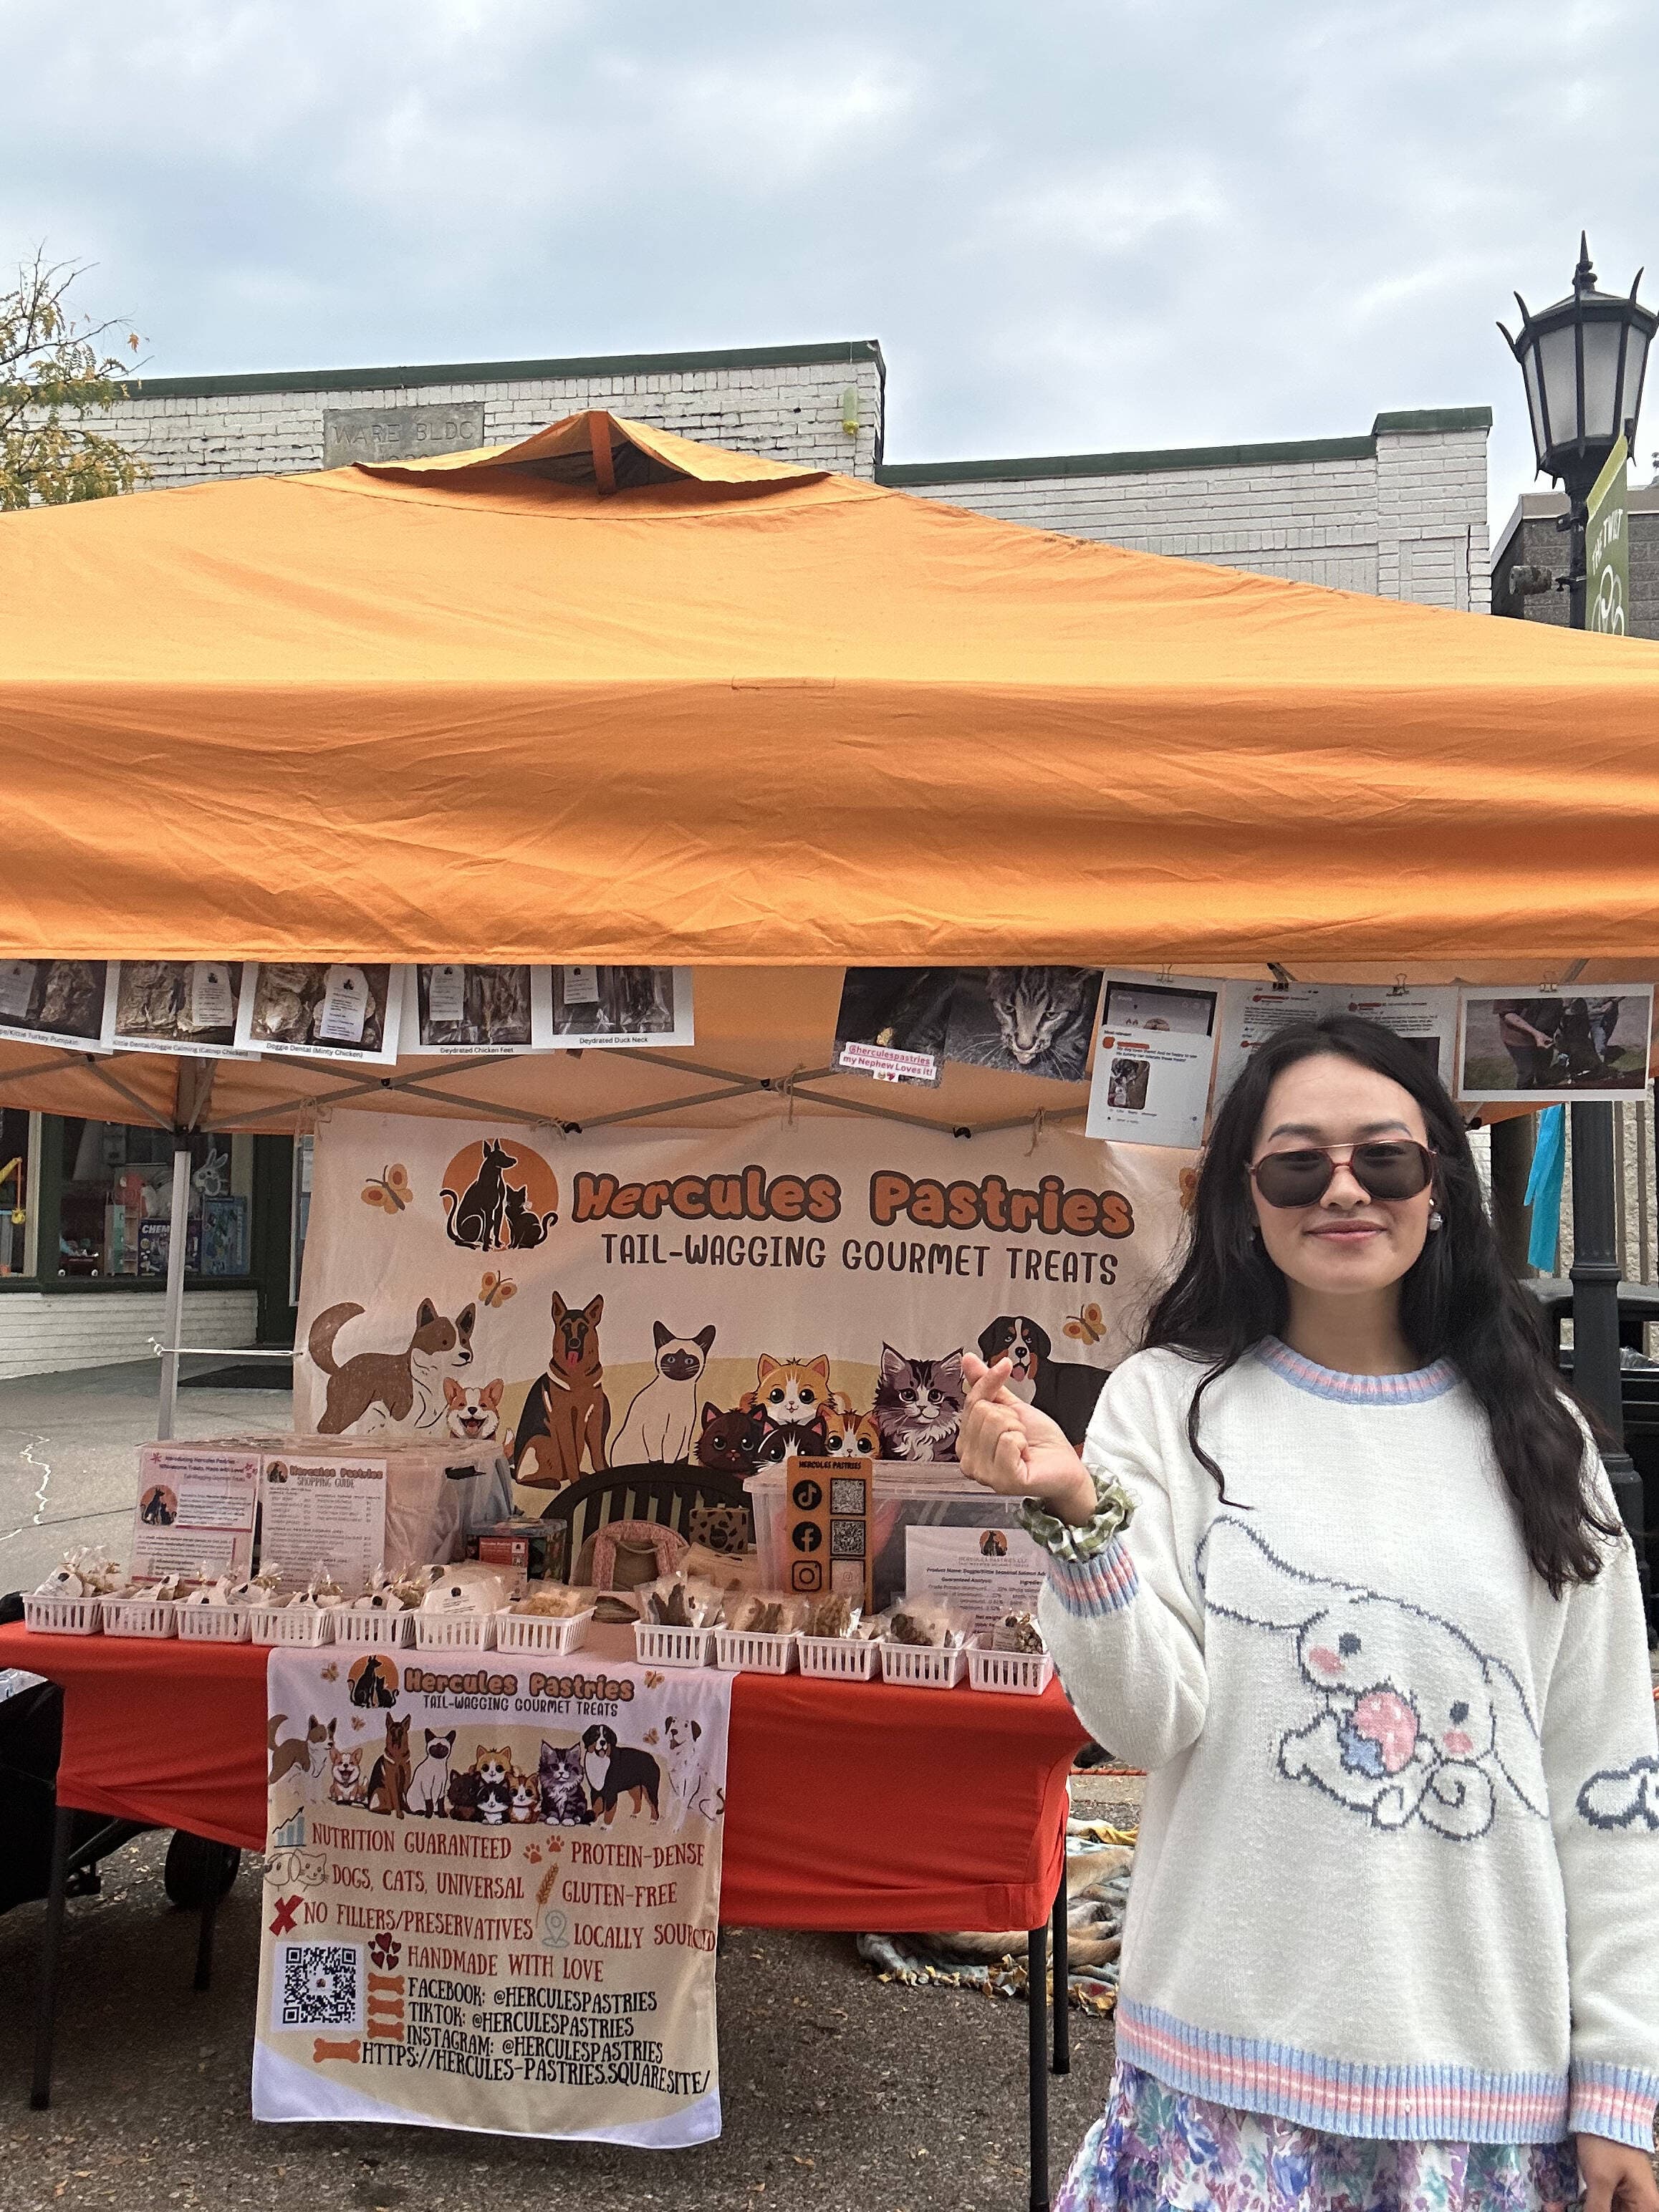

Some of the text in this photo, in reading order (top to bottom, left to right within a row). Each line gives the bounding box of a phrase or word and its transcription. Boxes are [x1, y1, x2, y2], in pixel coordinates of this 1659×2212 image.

[332, 424, 400, 444] WARE
[843, 1055, 857, 1064] my
[858, 1057, 894, 1069] Nephew
[895, 1062, 921, 1074] Loves
[849, 1044, 931, 1065] @herculespastries
[572, 1164, 1135, 1239] Hercules Pastries
[602, 1234, 1119, 1286] TAIL-WAGGING GOURMET TREATS
[297, 1476, 355, 1489] SHOPPING GUIDE
[405, 1667, 635, 1702] Hercules Pastries
[423, 1695, 618, 1717] TAIL-WAGGING GOURMET TREATS
[312, 1822, 511, 1860] NUTRITION GUARANTEED
[572, 1841, 705, 1868] PROTEIN-DENSE
[332, 1865, 524, 1899] DOGS, CATS, UNIVERSAL
[562, 1880, 677, 1908] GLUTEN-FREE
[304, 1902, 533, 1941] NO FILLERS/PRESERVATIVES
[574, 1923, 644, 1949] LOCALLY
[408, 1946, 603, 1983] HANDMADE WITH LOVE
[408, 1977, 658, 2014] FACEBOOK: @HERCULESPASTRIES
[408, 2001, 635, 2038] TIKTOK: @HERCULESPASTRIES
[408, 2025, 663, 2064] INSTAGRAM: @HERCULESPASTRIES
